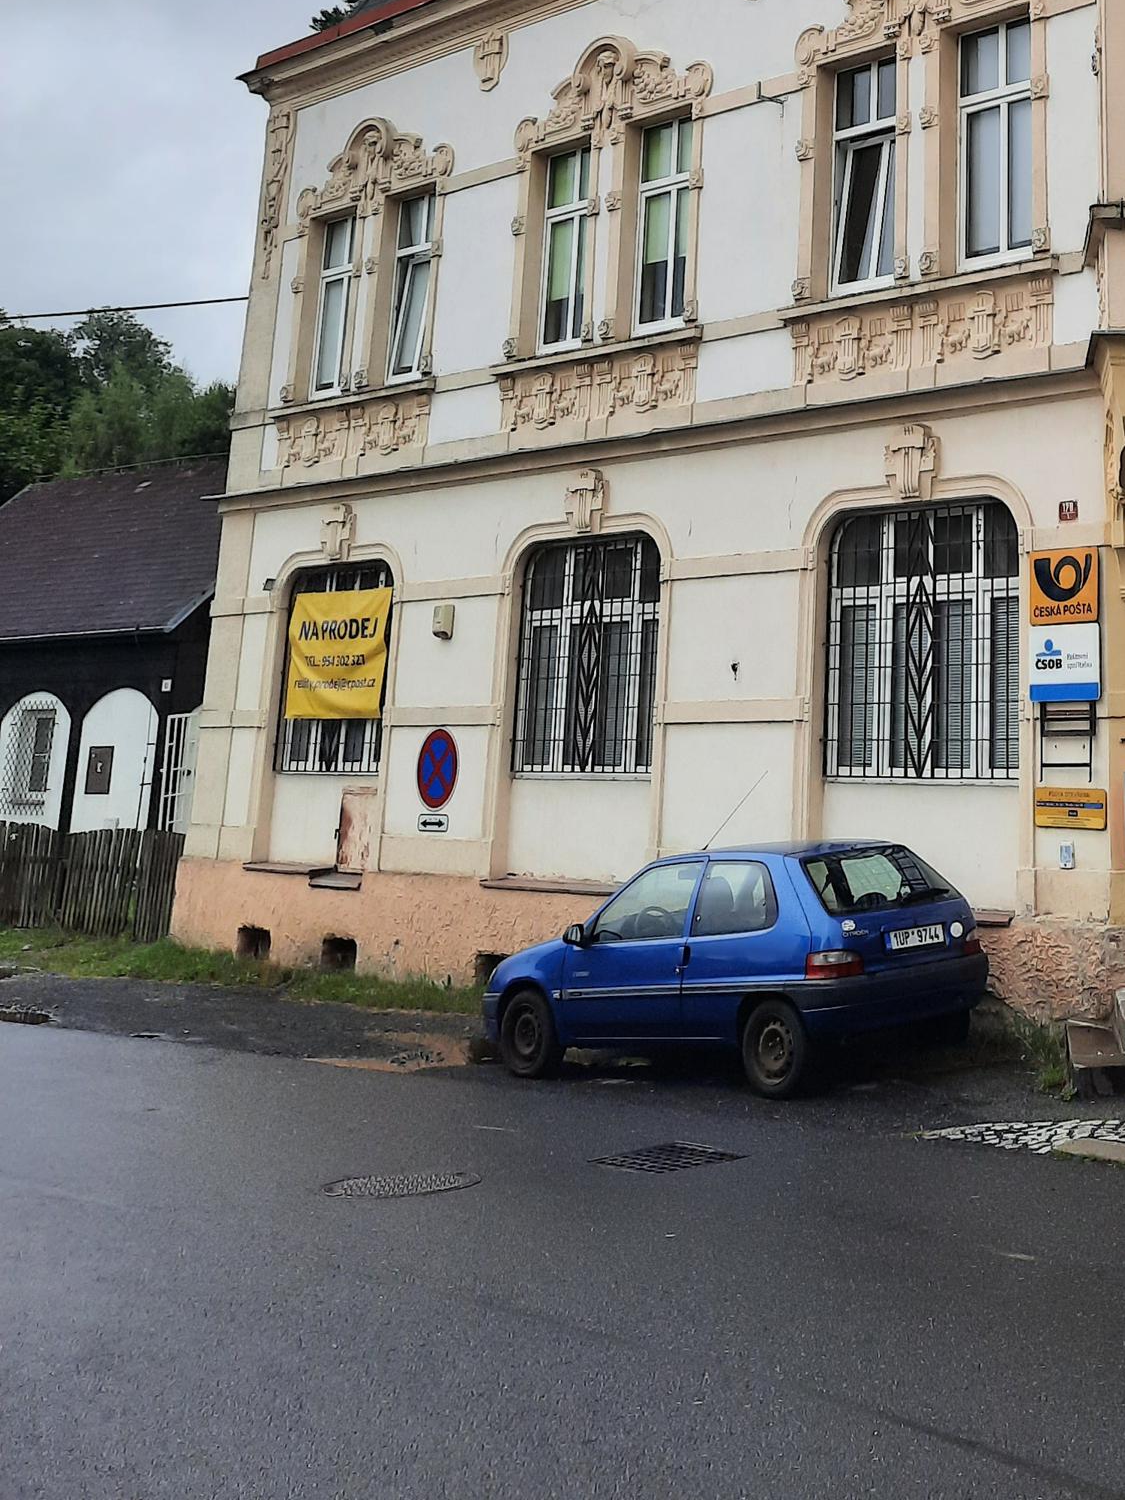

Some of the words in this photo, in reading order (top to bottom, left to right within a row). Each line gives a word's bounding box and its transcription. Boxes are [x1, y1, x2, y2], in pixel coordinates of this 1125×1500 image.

[1033, 604, 1061, 618] ČESKÁ
[1063, 602, 1093, 615] POŠTA
[298, 620, 319, 641] NA
[322, 617, 378, 640] PRODEJ
[1035, 658, 1063, 670] ČSOB
[916, 927, 940, 943] 9744
